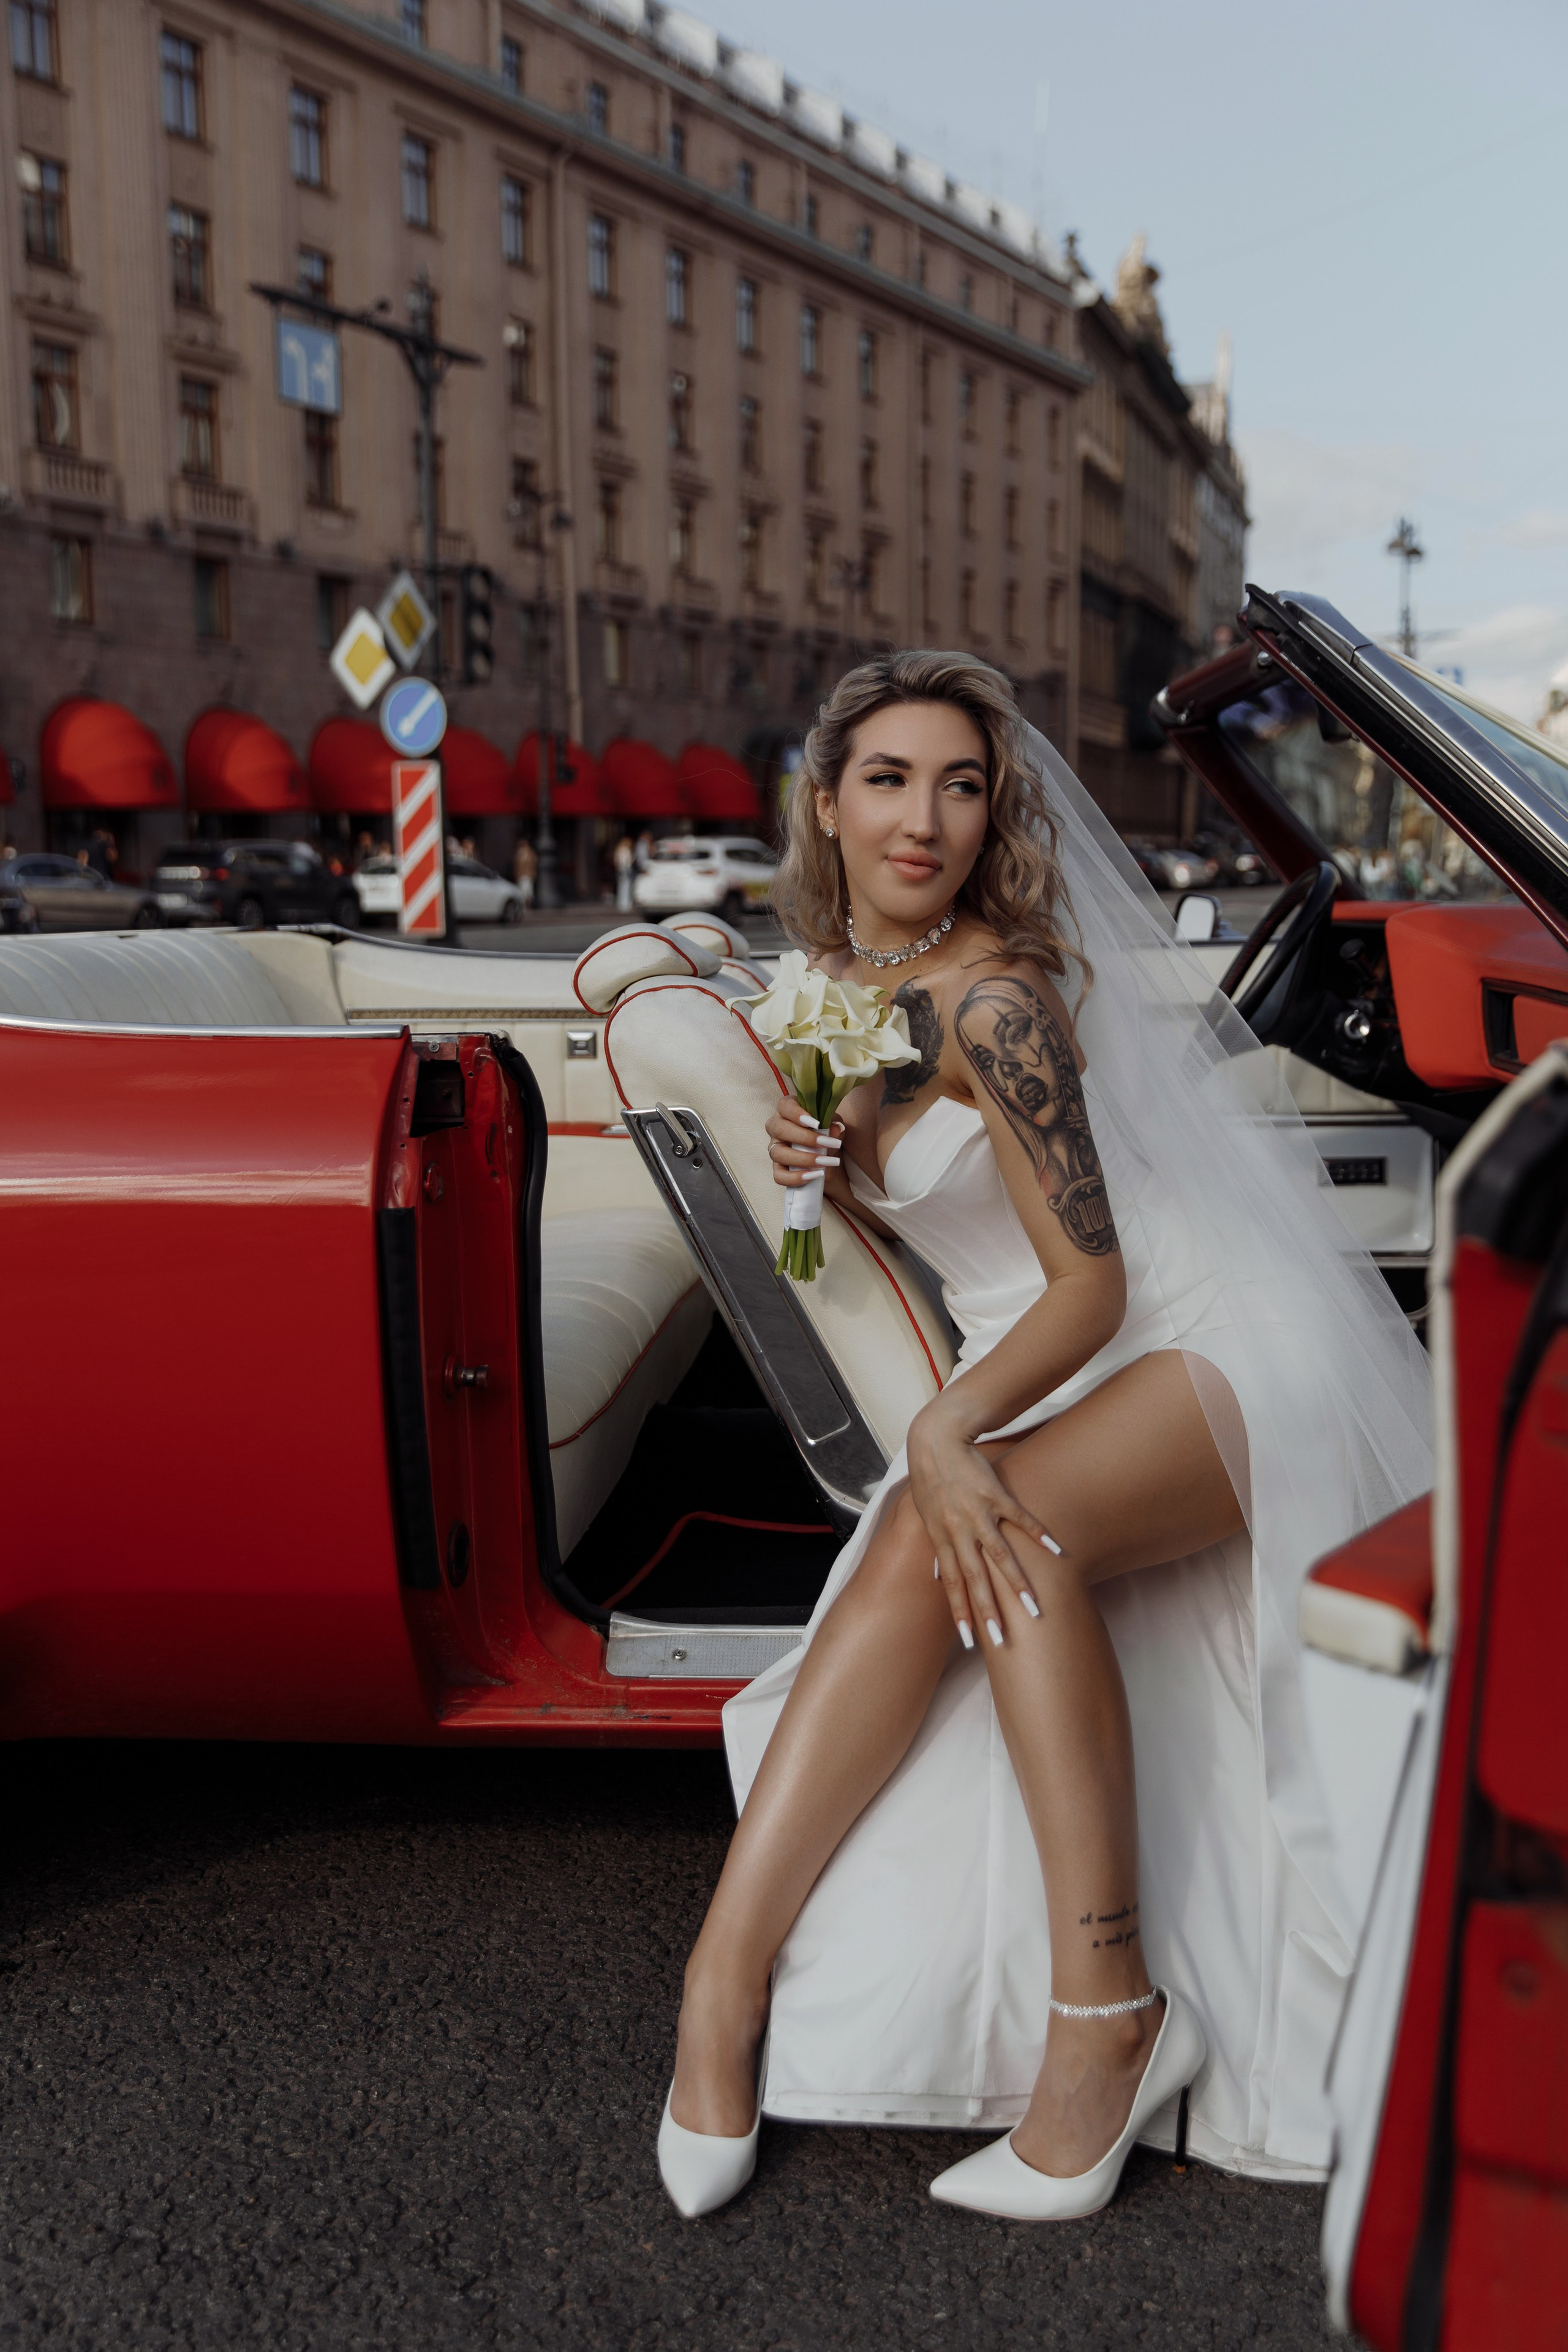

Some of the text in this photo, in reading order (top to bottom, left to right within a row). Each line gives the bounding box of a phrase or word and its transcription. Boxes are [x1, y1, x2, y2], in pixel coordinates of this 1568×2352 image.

[1080, 1911, 1092, 1924] el
[1098, 1904, 1130, 1923] mundo
[1093, 1940, 1100, 1948] a
[1106, 1931, 1123, 1946] mis
